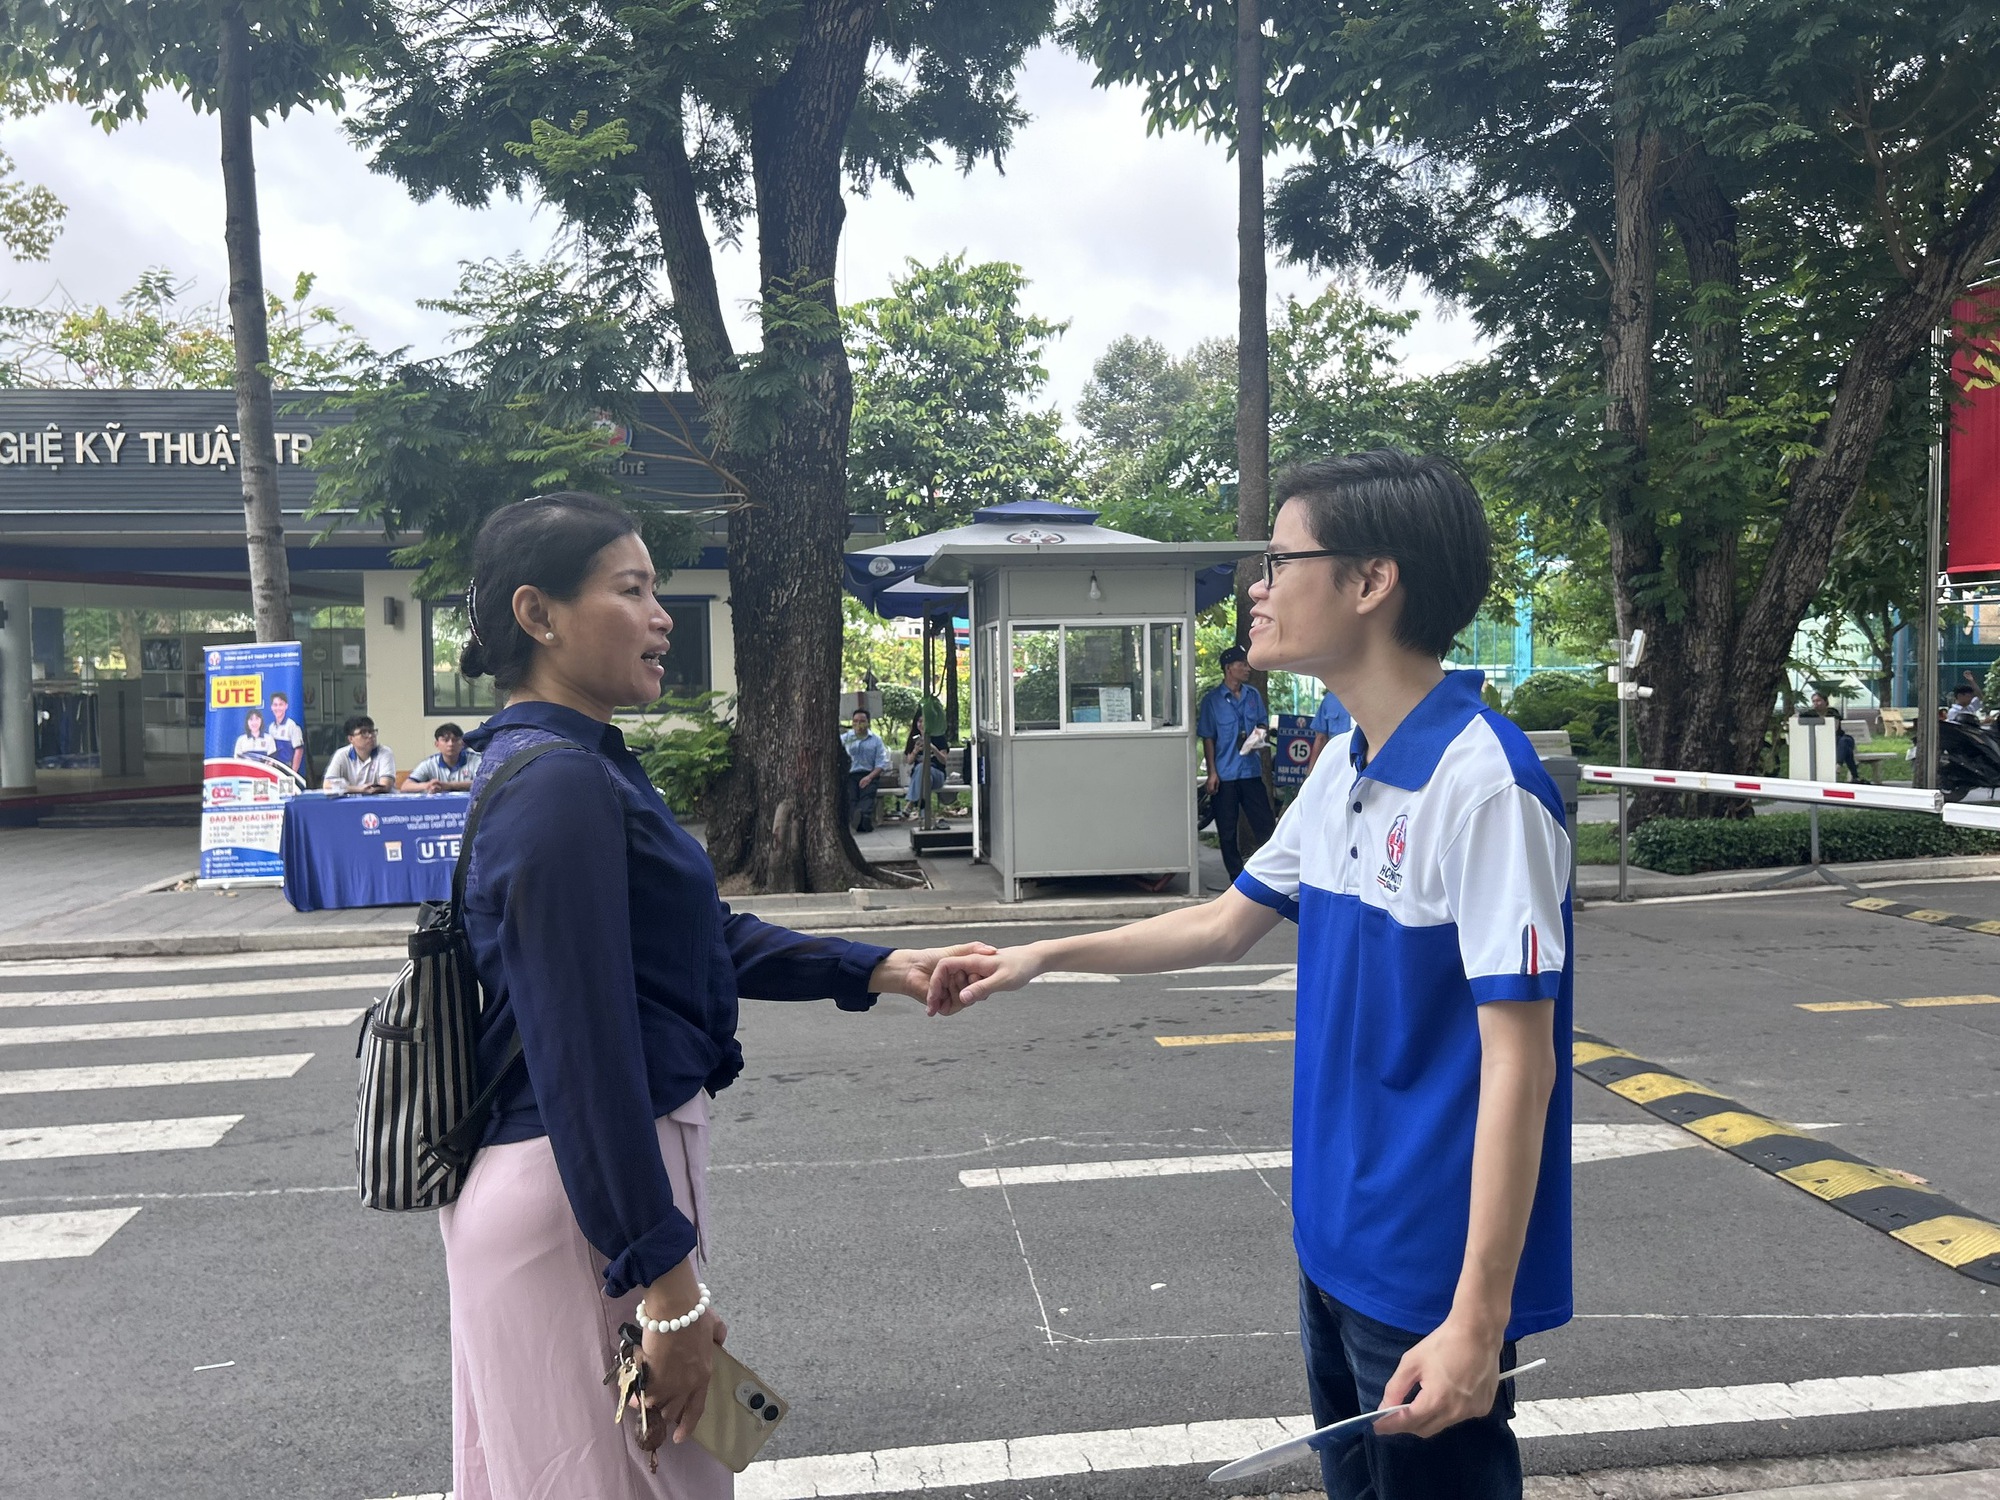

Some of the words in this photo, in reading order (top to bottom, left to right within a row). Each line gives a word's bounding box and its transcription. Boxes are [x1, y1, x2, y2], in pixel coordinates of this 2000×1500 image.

[75, 422, 126, 464] KỸ
[216, 688, 255, 704] UTE
[1292, 744, 1308, 758] 15
[421, 841, 461, 858] UTE
